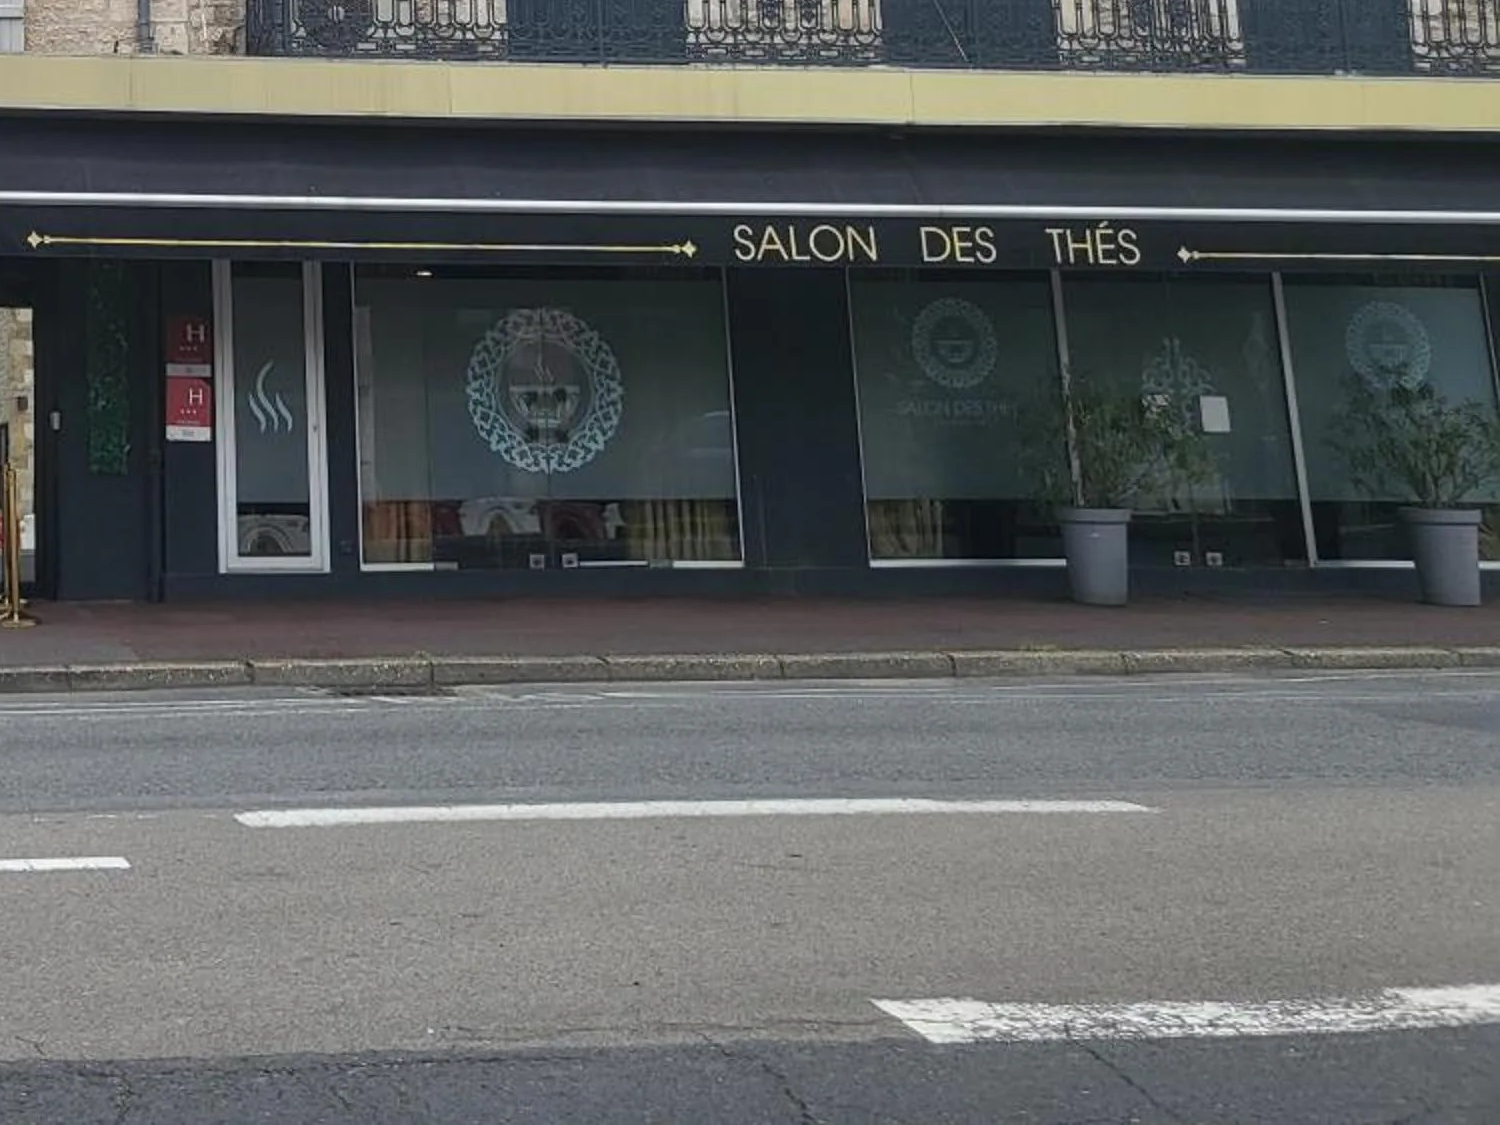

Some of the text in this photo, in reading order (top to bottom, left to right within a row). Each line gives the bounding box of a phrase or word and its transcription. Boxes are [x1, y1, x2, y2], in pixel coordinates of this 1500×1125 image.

[733, 221, 1142, 265] SALON DES THÉS
[186, 323, 205, 344] H
[189, 386, 203, 406] H
